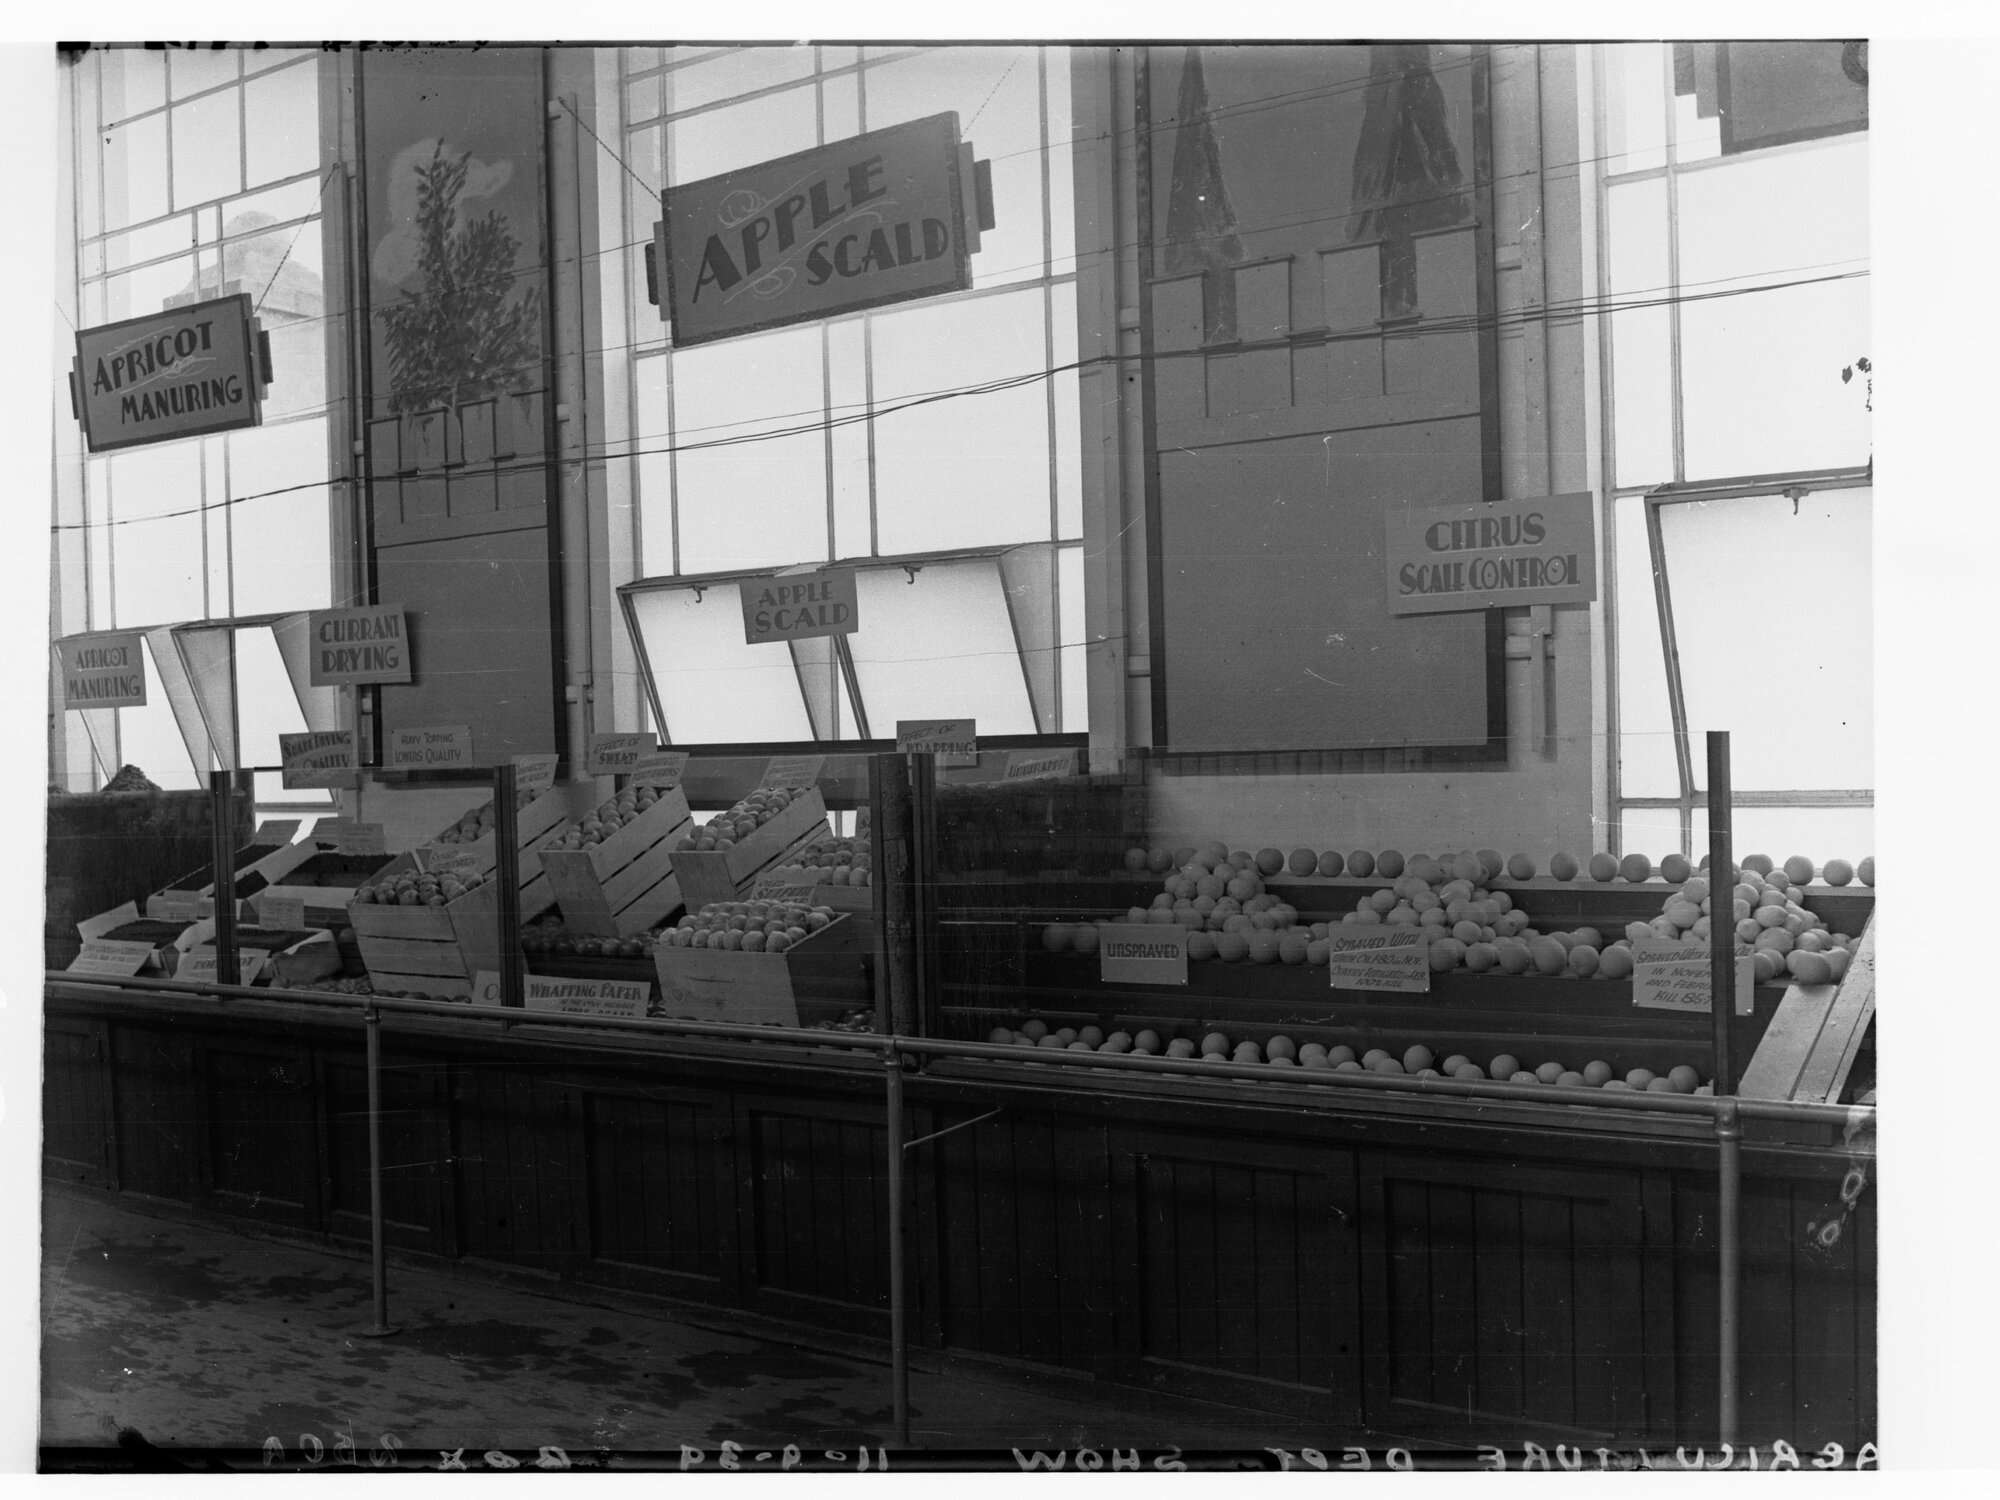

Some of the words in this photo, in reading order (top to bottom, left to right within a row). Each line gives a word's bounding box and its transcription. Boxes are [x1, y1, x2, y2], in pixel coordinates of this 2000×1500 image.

[692, 155, 887, 303] APPLE
[806, 218, 949, 285] SCALD
[93, 321, 213, 396] APRICOT
[122, 375, 243, 424] MANURING
[1425, 513, 1546, 551] CITRUS
[1399, 562, 1465, 595] SCALE
[1468, 554, 1581, 590] CONTROL
[759, 581, 833, 607] APPLE
[319, 613, 399, 643] CURRANT
[755, 603, 849, 633] SCALD
[76, 646, 128, 667] APRICOT
[321, 645, 399, 673] DRYING
[69, 674, 140, 699] MANURING
[426, 748, 461, 763] QUALITY
[1107, 943, 1179, 958] UNSPRAYED
[1333, 937, 1385, 952] SPRAYED
[1389, 932, 1420, 947] WITH
[1645, 978, 1671, 987] AND
[1673, 979, 1711, 990] FEBRU
[1651, 967, 1666, 975] IN
[1671, 967, 1711, 978] NOVEM
[530, 982, 596, 998] WRAPPING
[601, 982, 641, 1000] PAPER
[1653, 990, 1679, 1002] KILL
